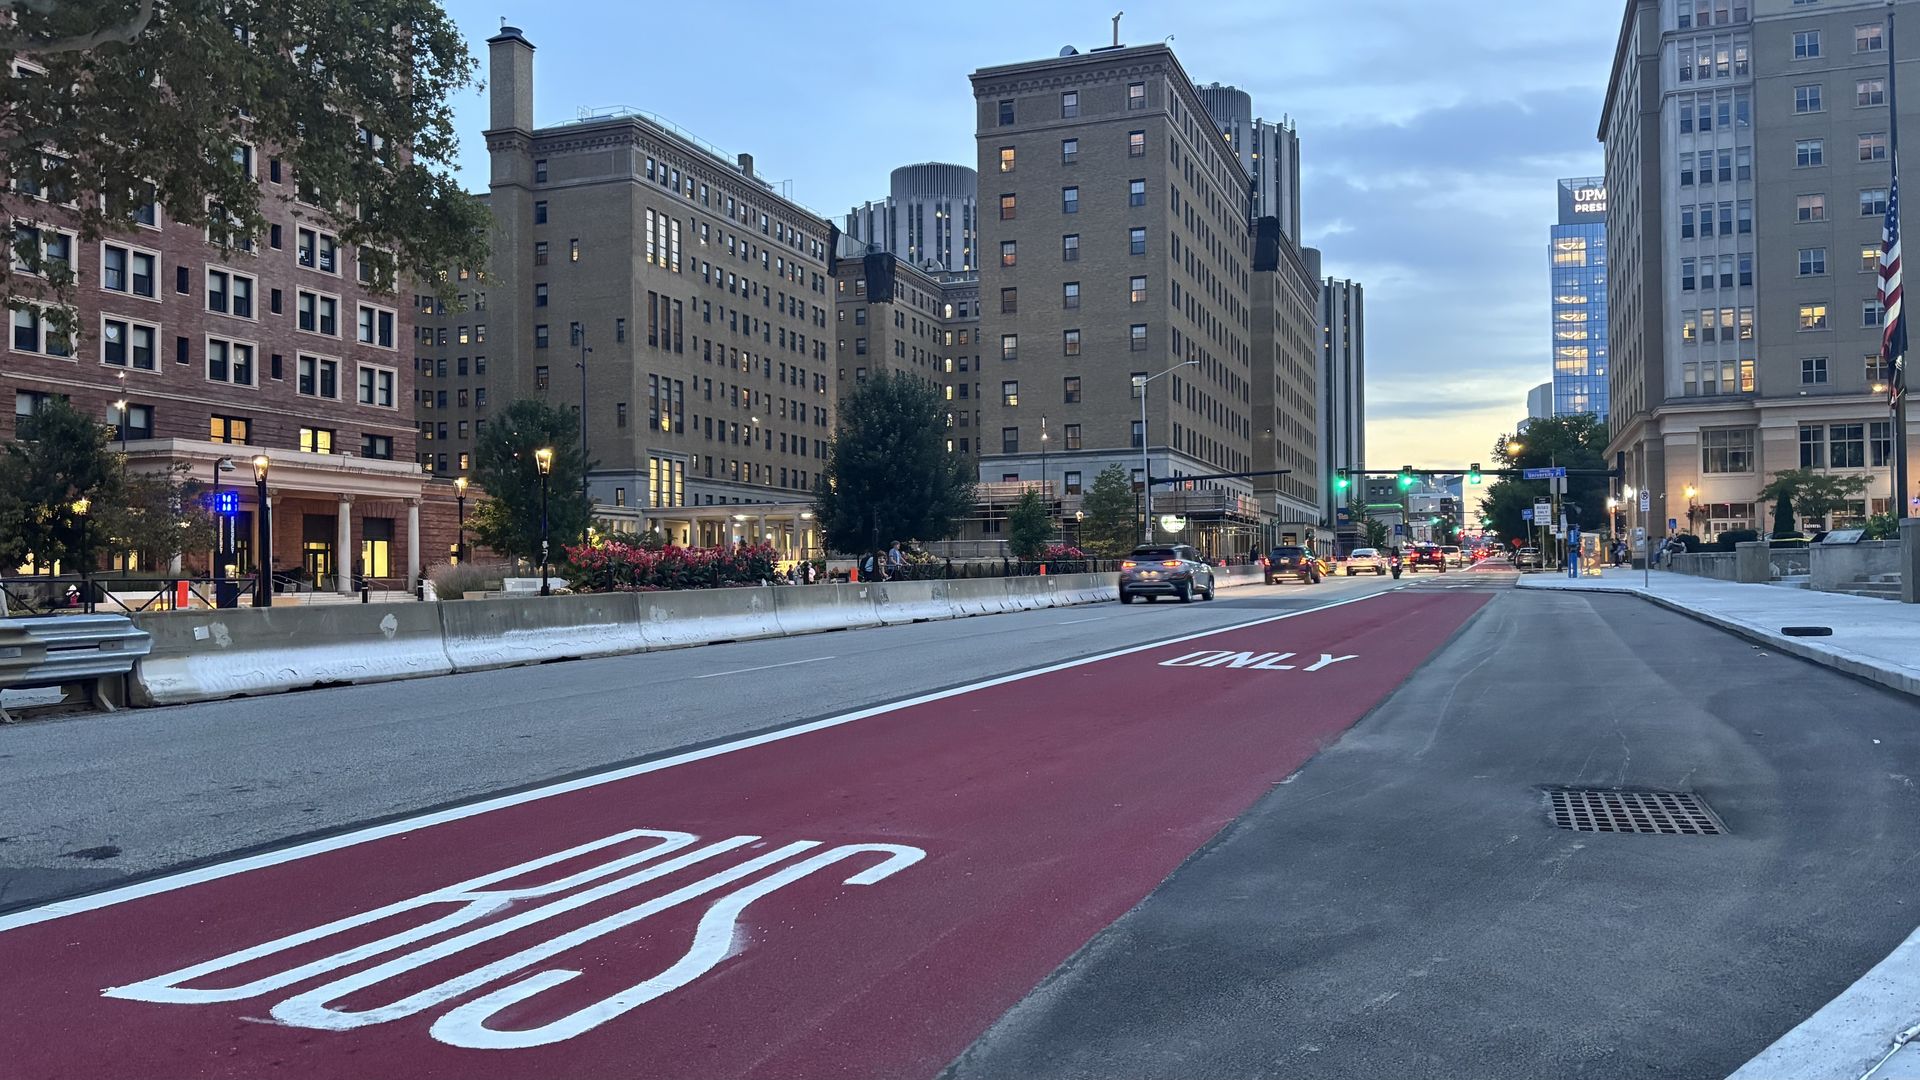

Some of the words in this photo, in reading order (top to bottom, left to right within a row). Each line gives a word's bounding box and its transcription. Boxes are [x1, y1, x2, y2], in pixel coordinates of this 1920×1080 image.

[1575, 202, 1607, 213] PRESI
[1157, 650, 1360, 671] ONLY
[101, 828, 927, 1050] BUS
